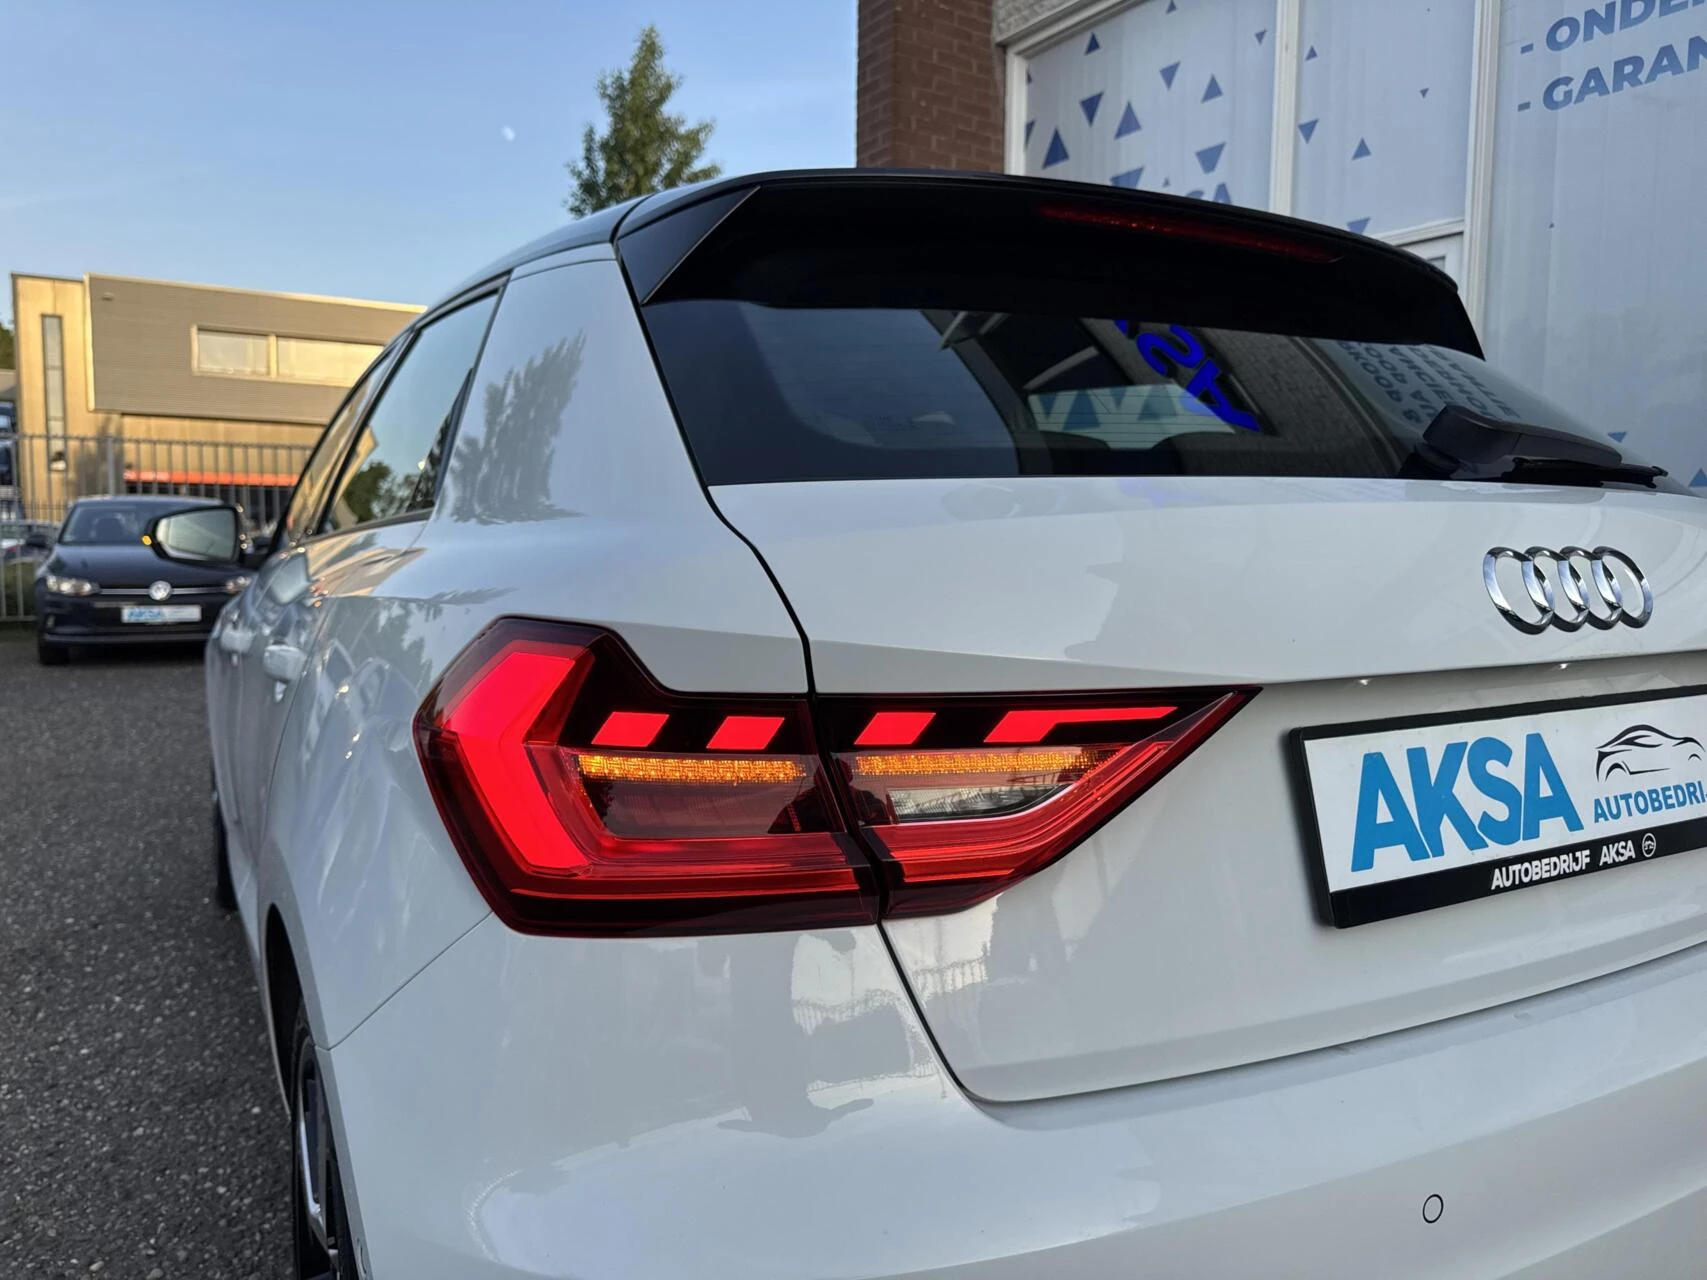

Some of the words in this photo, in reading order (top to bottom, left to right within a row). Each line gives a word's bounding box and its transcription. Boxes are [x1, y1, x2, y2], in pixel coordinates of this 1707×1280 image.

[1351, 732, 1584, 873] AKSA
[1594, 780, 1707, 823] AUTOBEDRI
[1491, 849, 1591, 890] AUTOBEDRIJF
[1599, 840, 1636, 866] AKSA
